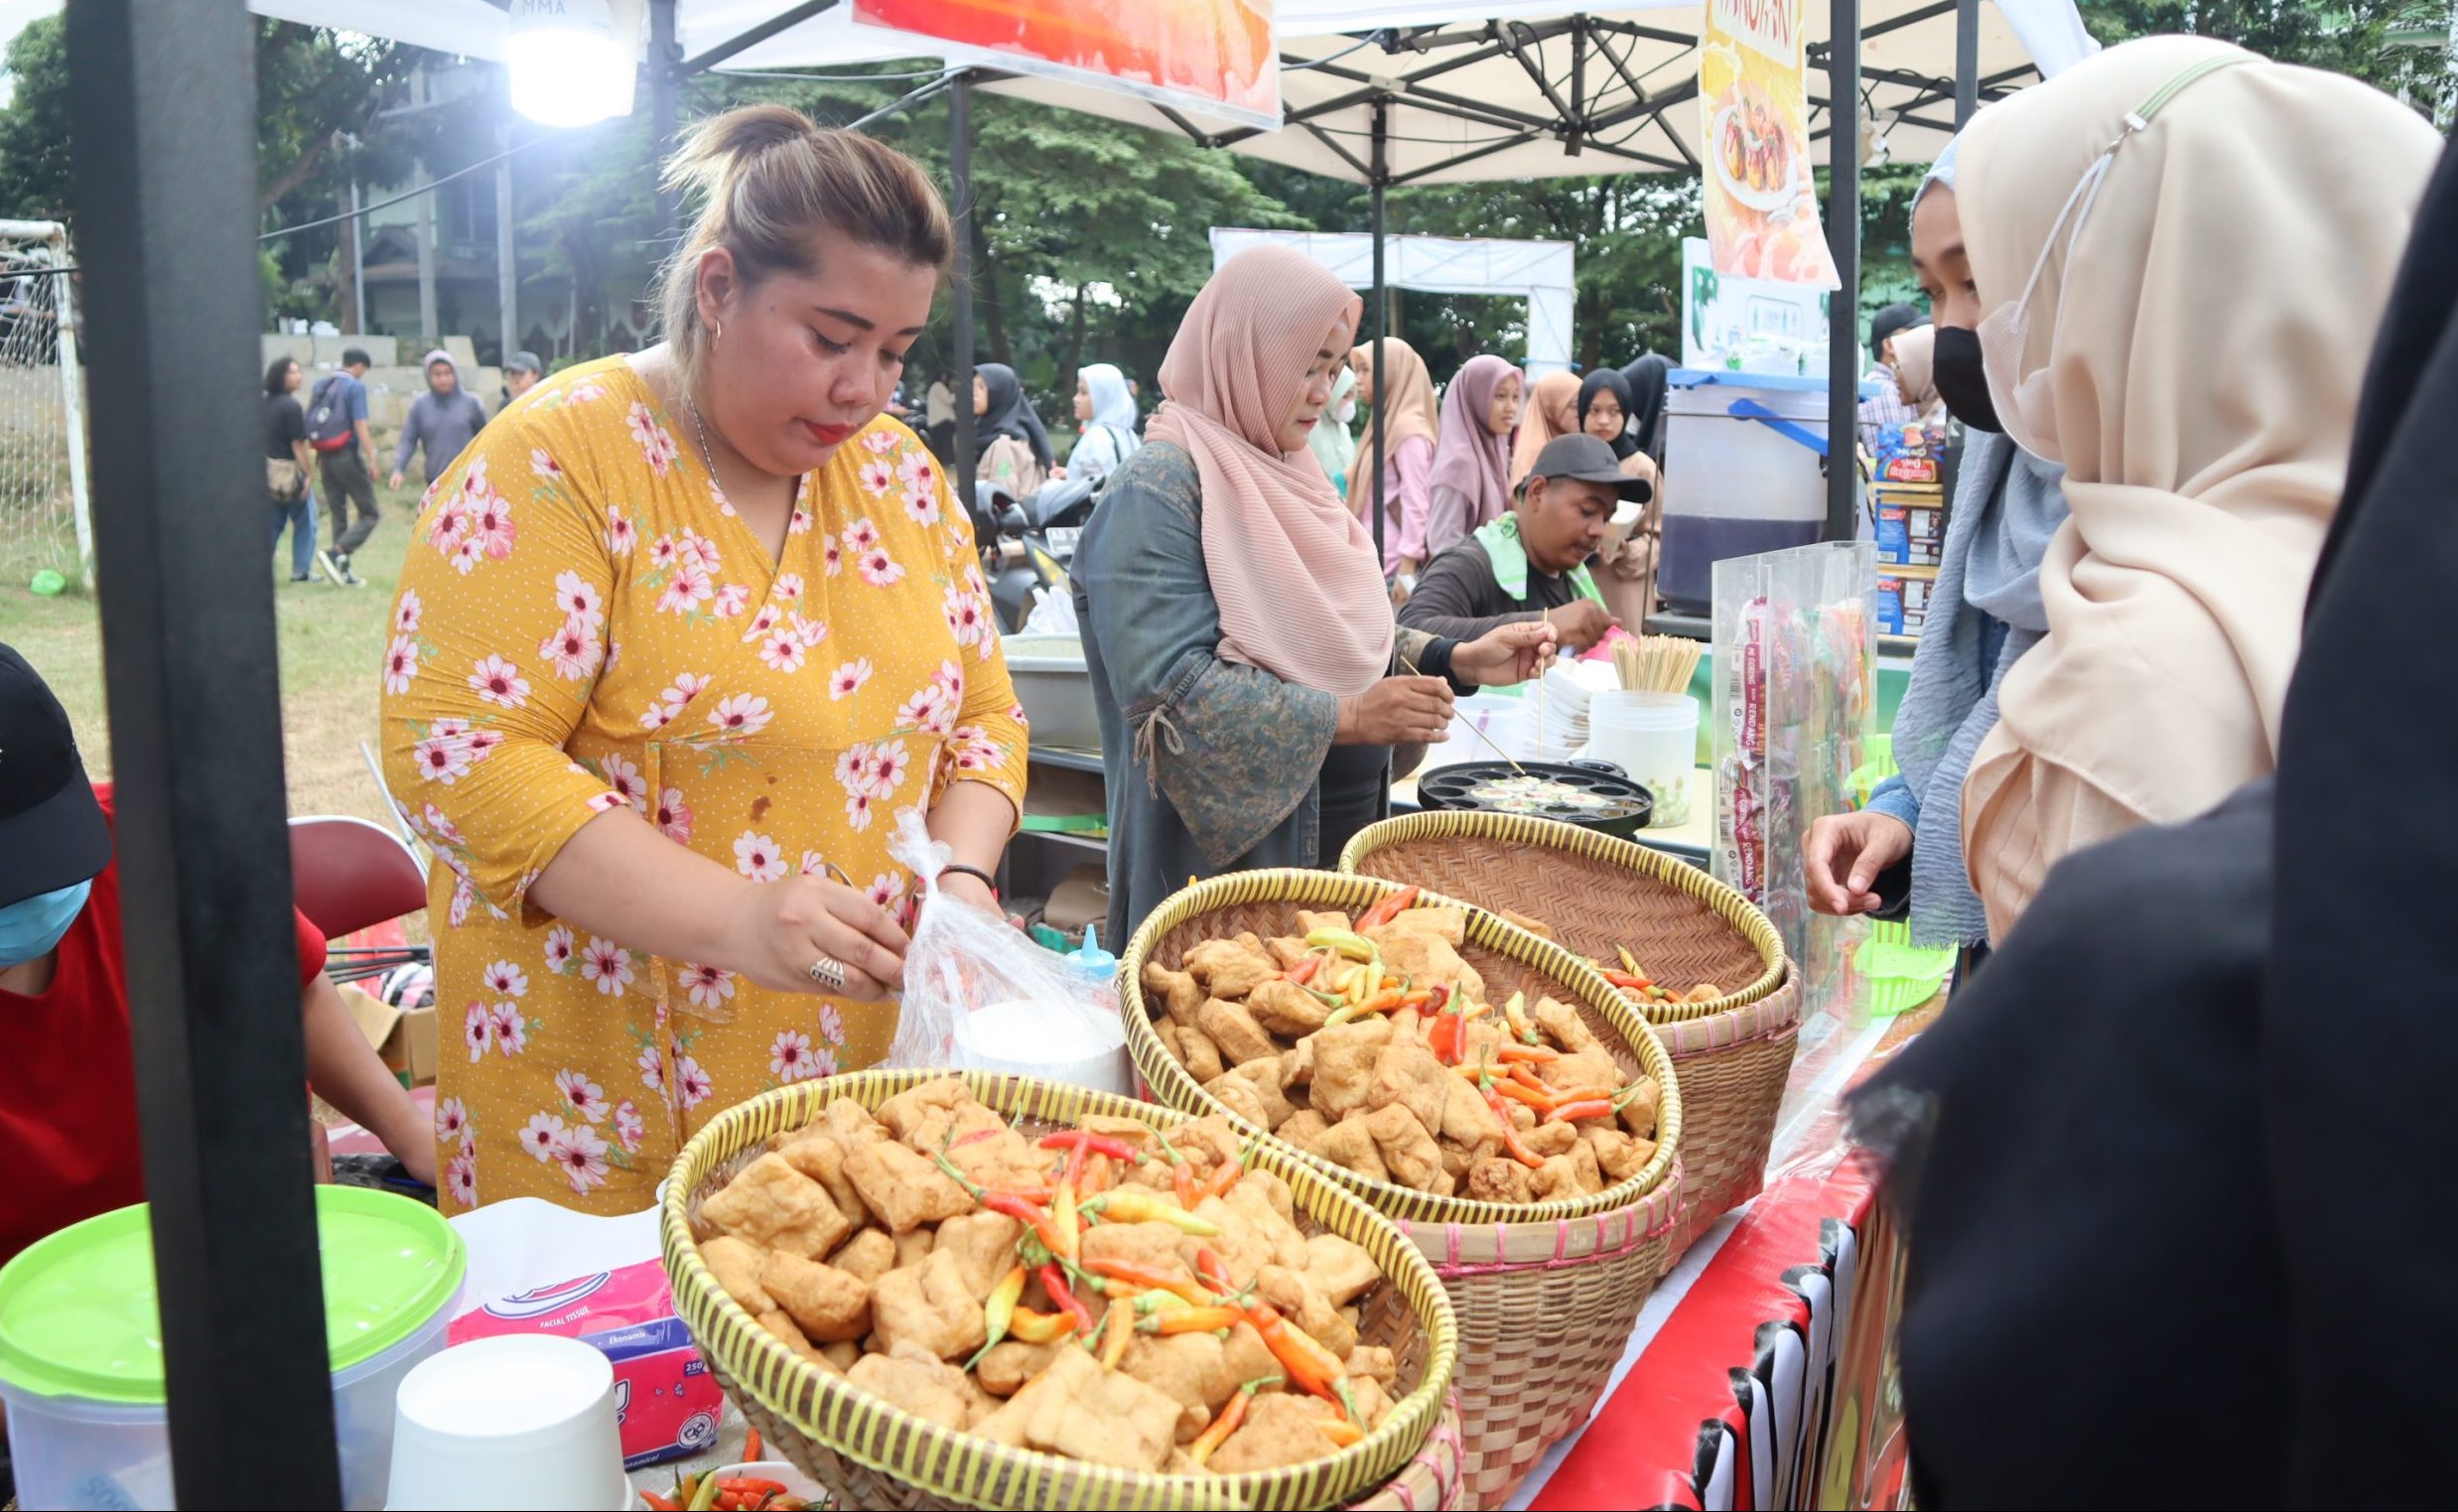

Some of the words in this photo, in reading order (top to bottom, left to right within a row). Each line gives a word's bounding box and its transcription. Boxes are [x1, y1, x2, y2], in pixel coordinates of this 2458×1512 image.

[1747, 657, 1756, 685] GORENG
[1745, 703, 1757, 747] RENDANG
[1742, 842, 1755, 886] RENDANG
[540, 1317, 566, 1328] FACIAL
[565, 1306, 590, 1323] TISSUE
[609, 1331, 646, 1344] Ekonomis
[685, 1361, 703, 1372] 250
